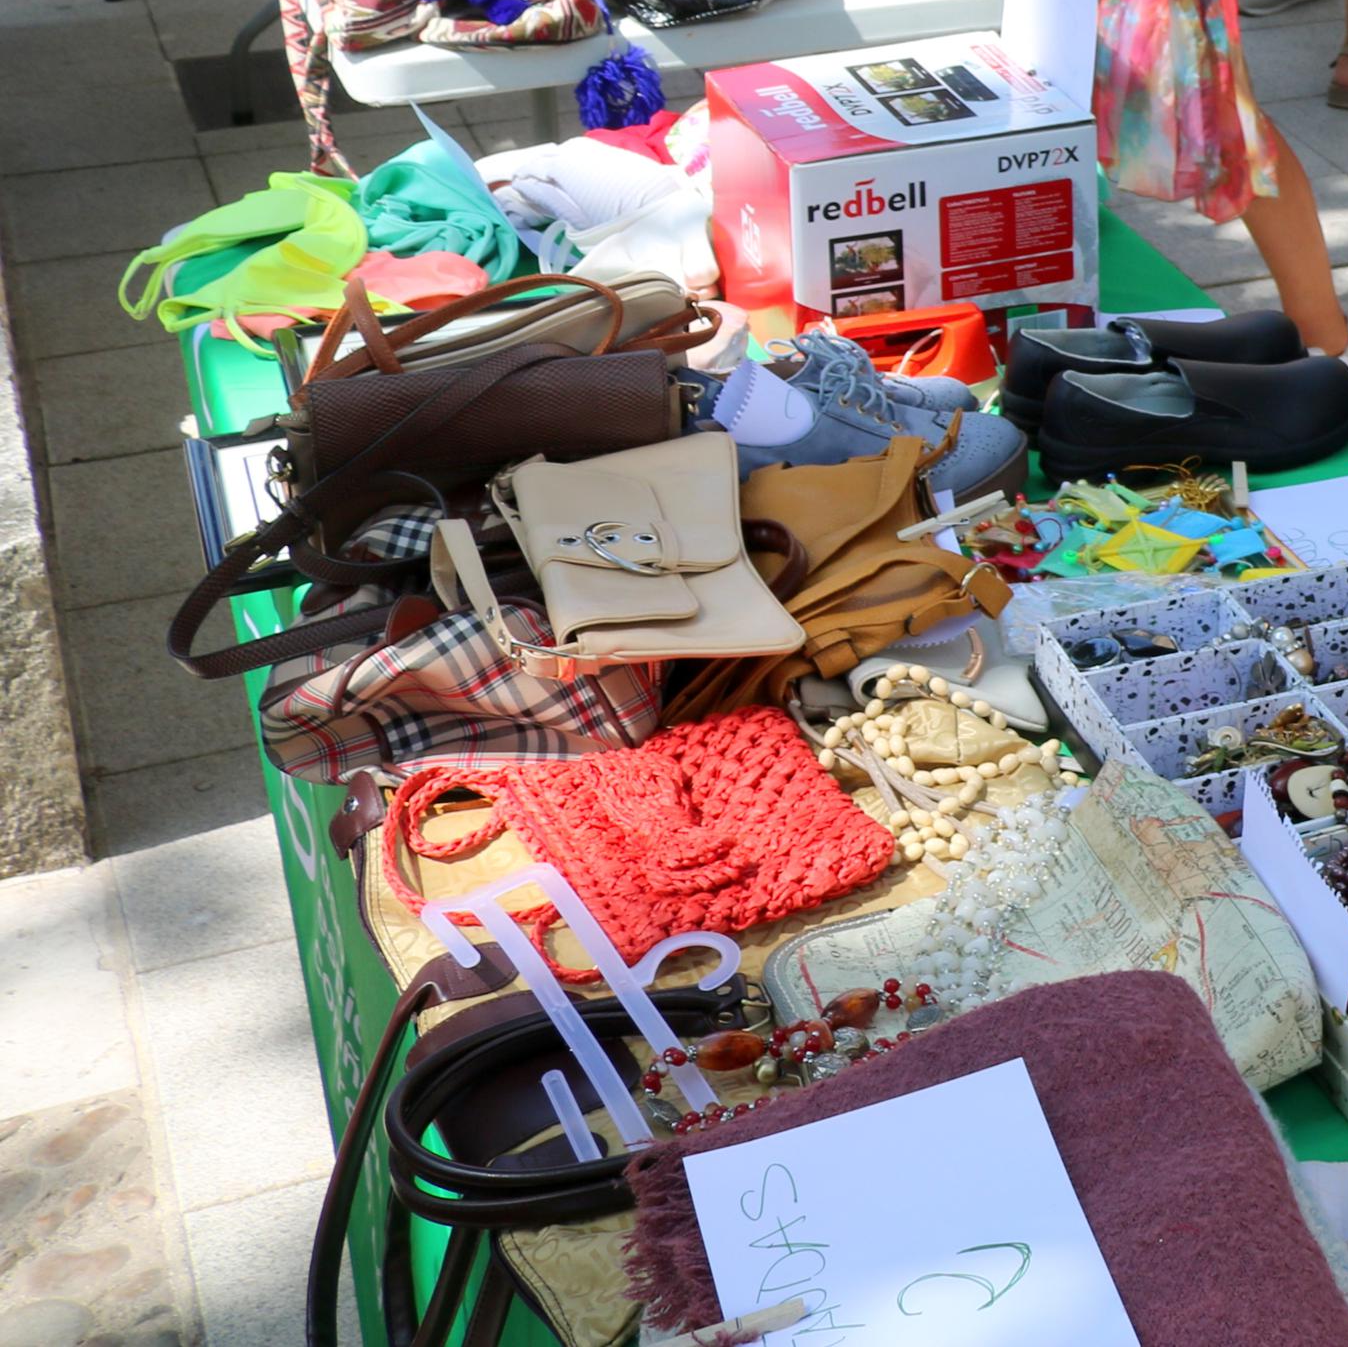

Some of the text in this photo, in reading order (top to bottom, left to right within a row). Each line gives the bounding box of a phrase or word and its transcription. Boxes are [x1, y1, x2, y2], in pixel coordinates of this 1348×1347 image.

[754, 84, 828, 131] redbell
[821, 82, 873, 117] DVP72X
[997, 146, 1079, 173] DVP72X
[807, 179, 927, 223] redbell
